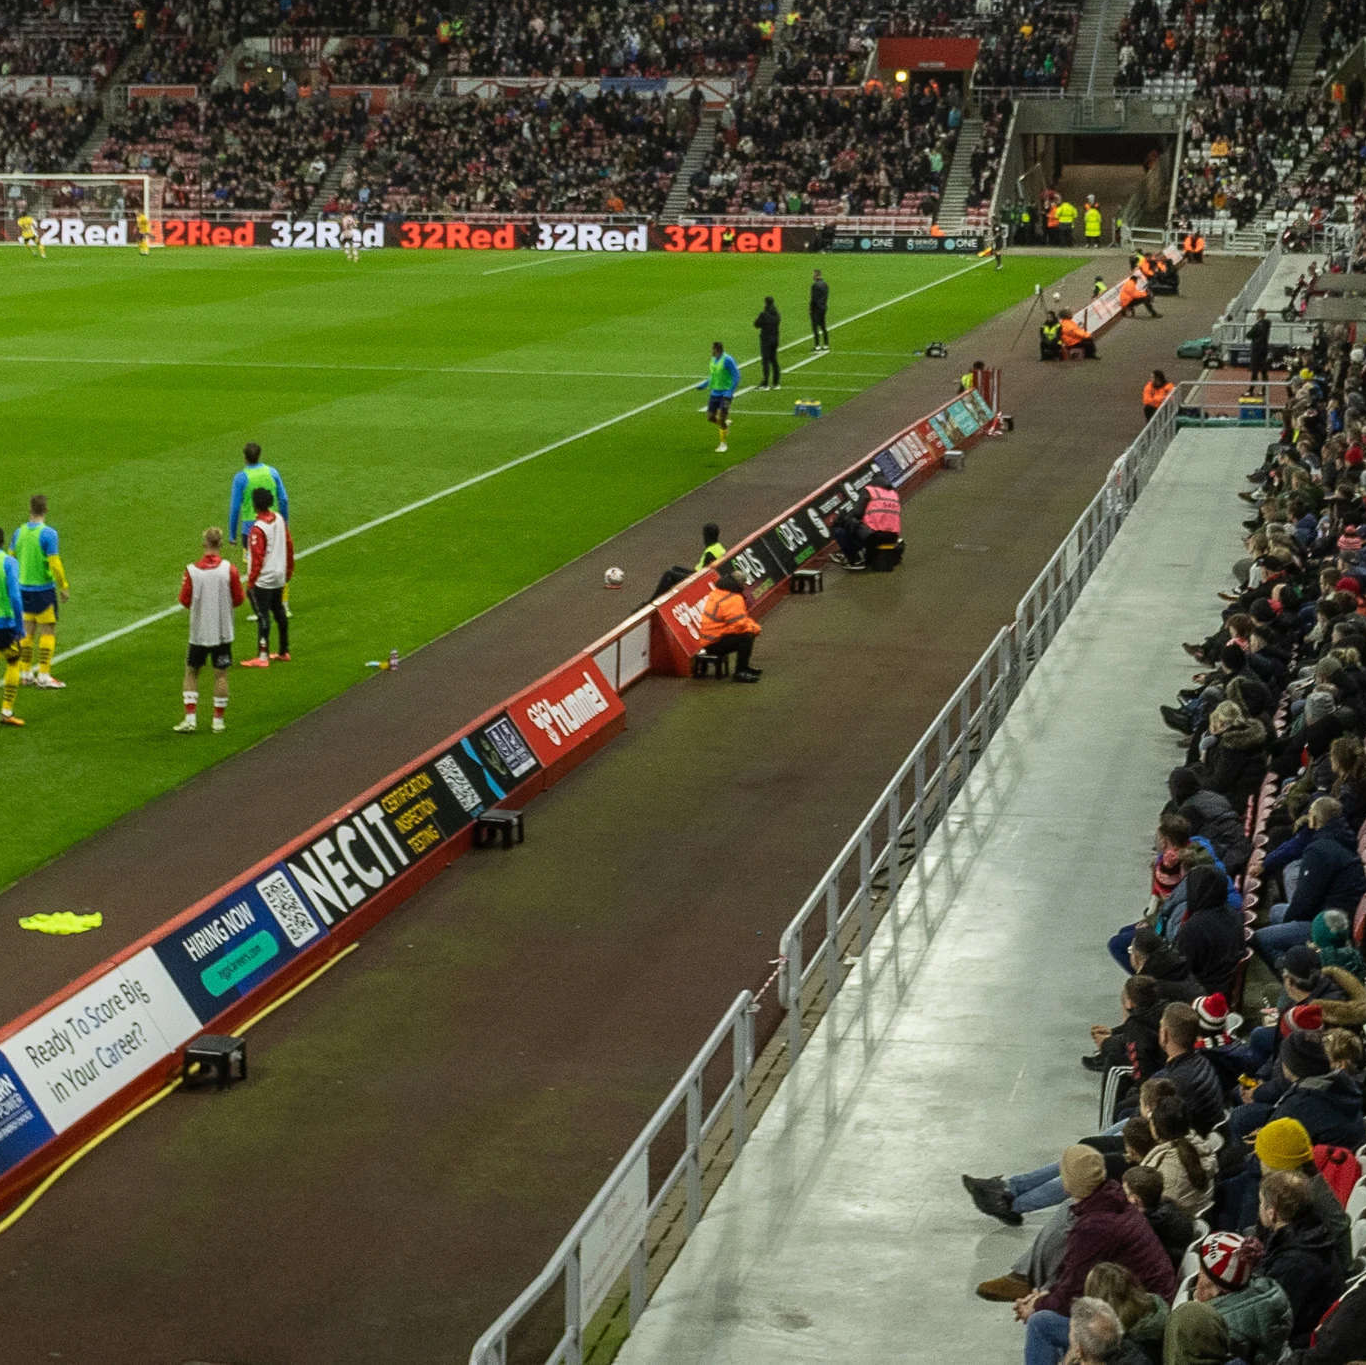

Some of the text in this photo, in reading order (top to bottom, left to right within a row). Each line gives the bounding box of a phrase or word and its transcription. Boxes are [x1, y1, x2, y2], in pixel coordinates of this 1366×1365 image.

[21, 218, 127, 245] 2Red
[400, 222, 516, 250] 32Red
[536, 223, 648, 252] 32Red
[550, 671, 609, 737] hummel
[287, 802, 410, 926] NECIT
[182, 900, 256, 962] HIRING NOW
[24, 979, 151, 1069] Ready To Score Big
[46, 1021, 148, 1104] in Your Career?
